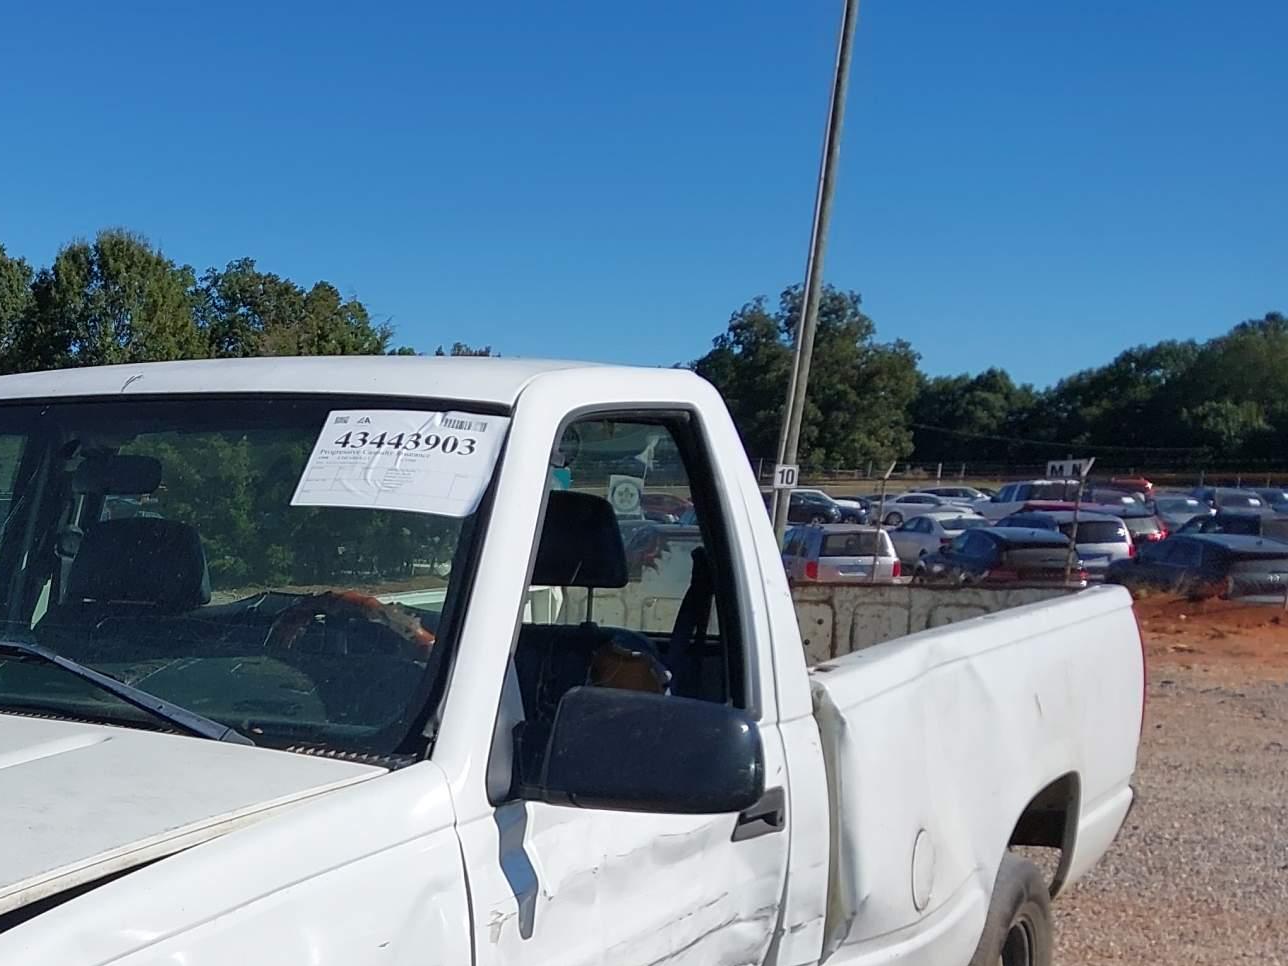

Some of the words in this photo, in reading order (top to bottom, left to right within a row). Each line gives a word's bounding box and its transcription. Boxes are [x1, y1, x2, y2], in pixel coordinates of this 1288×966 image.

[334, 430, 477, 456] 43443903
[778, 468, 795, 485] 10
[1051, 464, 1064, 476] M
